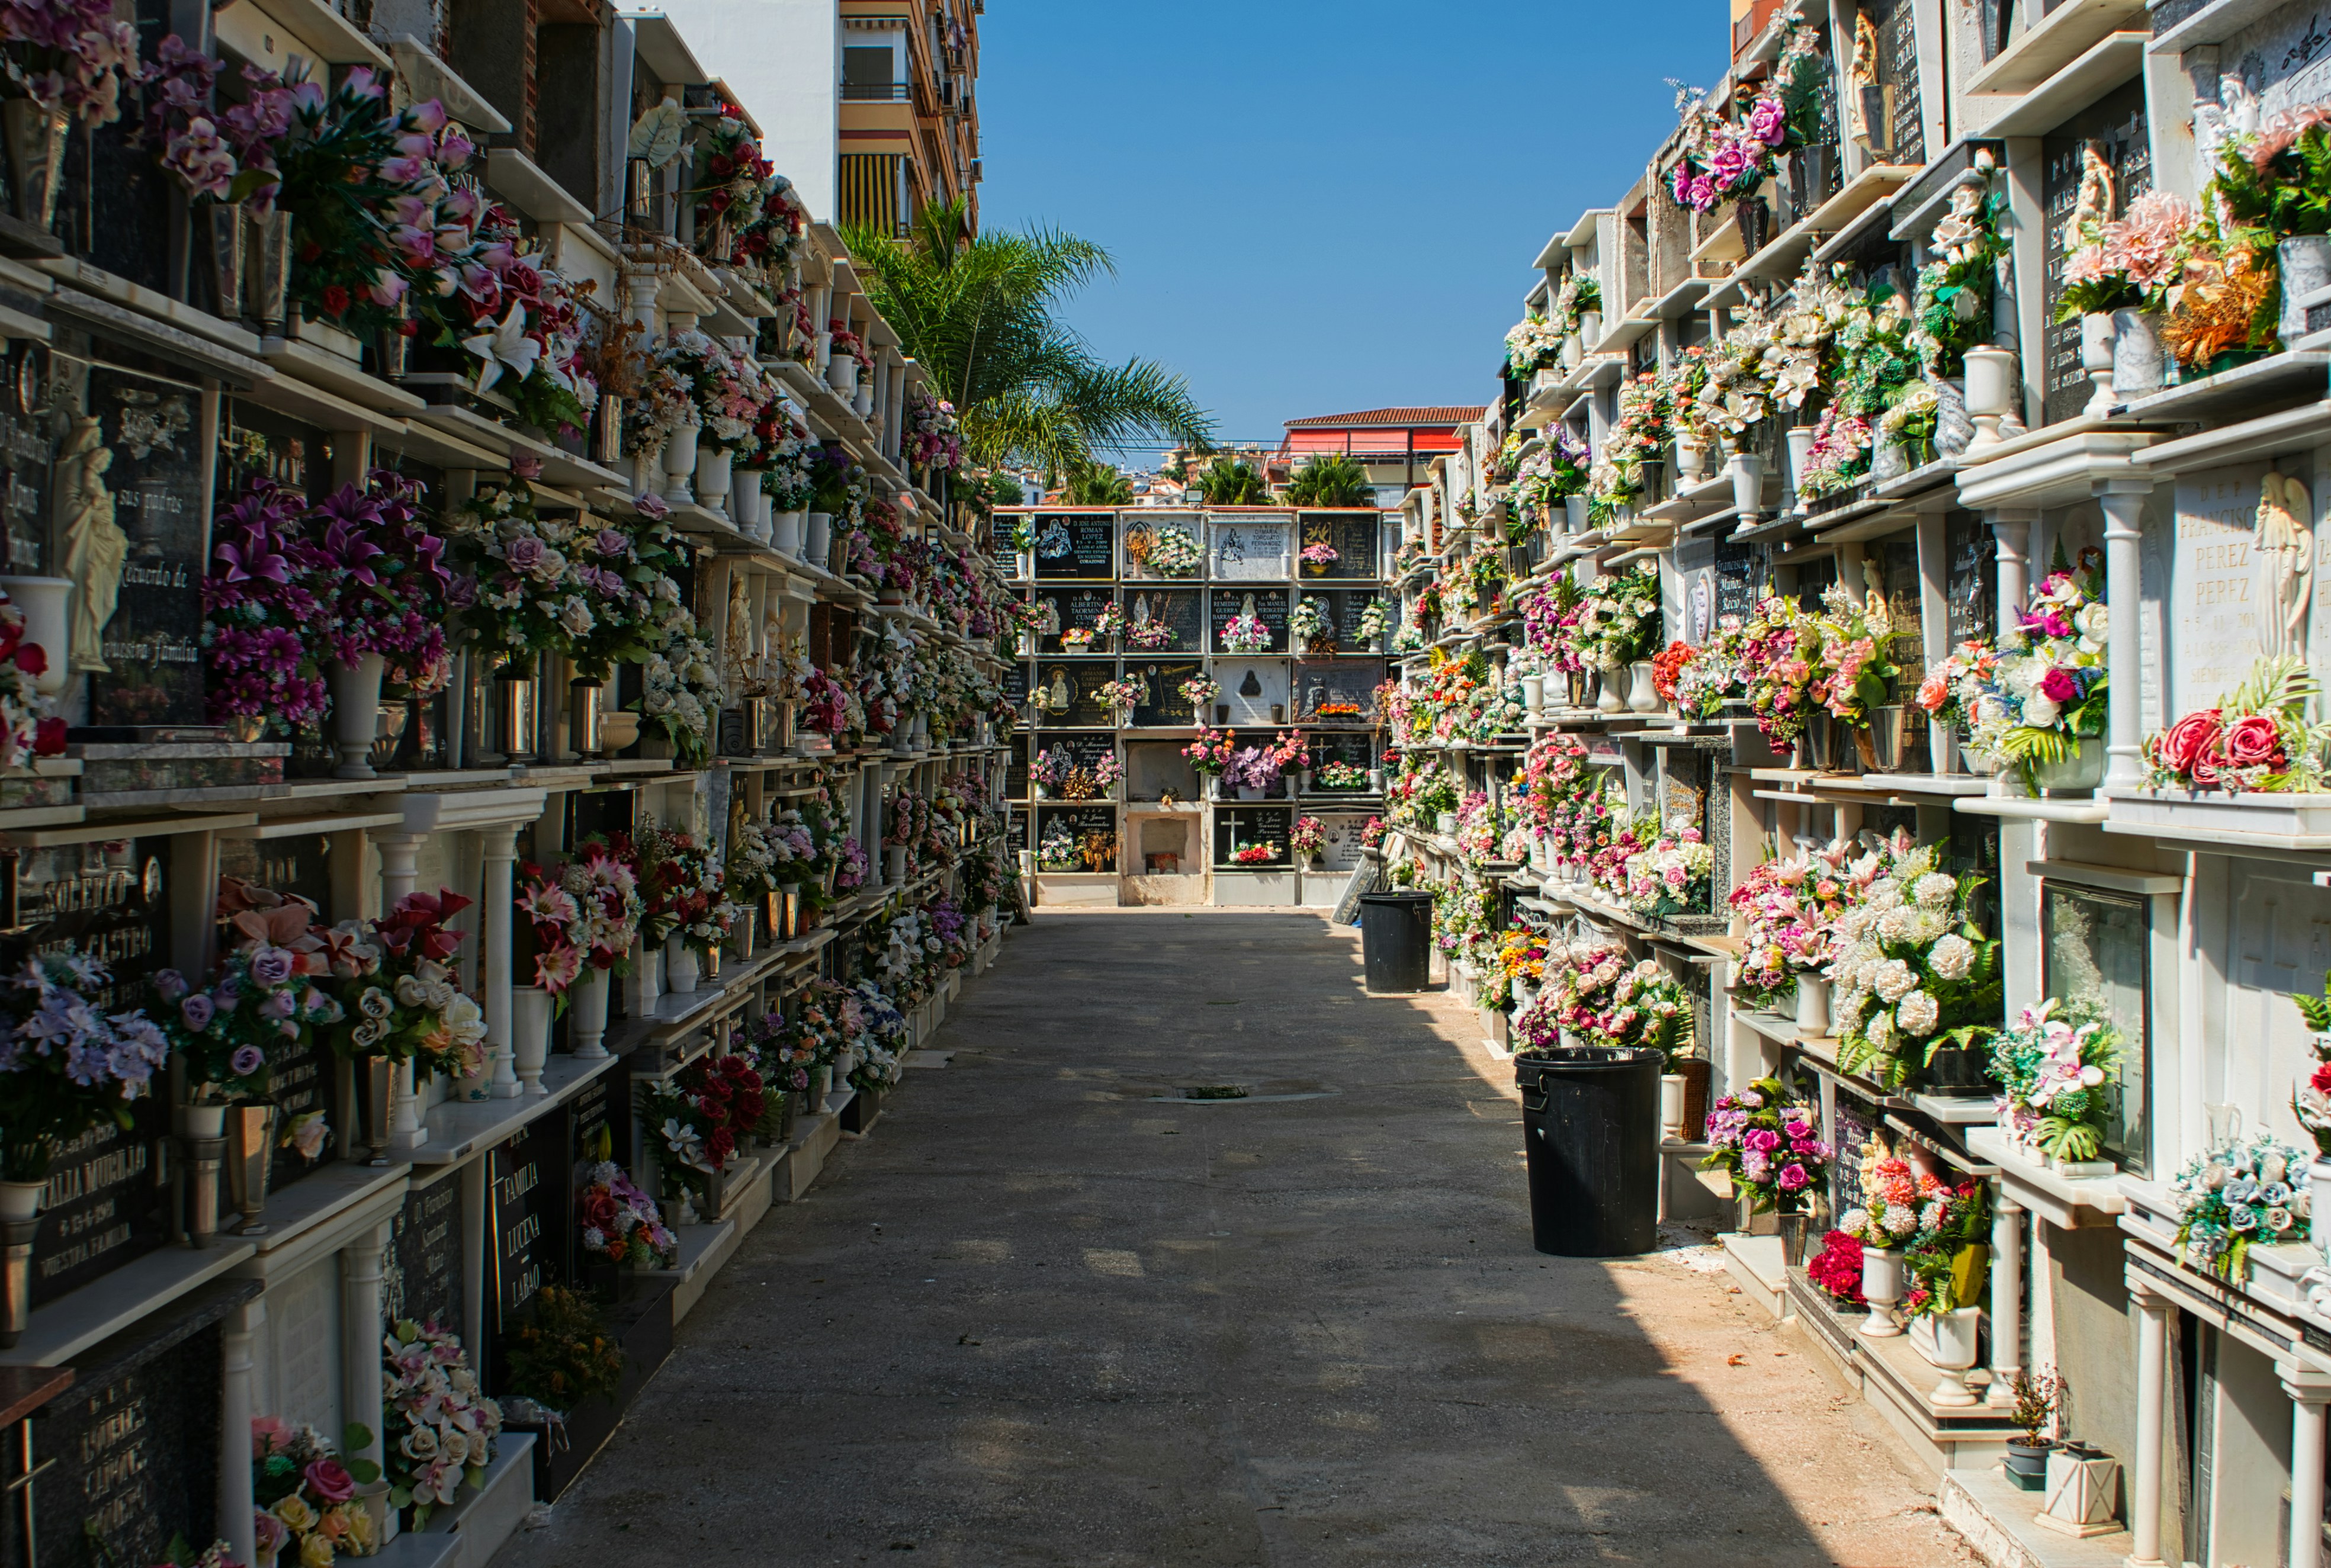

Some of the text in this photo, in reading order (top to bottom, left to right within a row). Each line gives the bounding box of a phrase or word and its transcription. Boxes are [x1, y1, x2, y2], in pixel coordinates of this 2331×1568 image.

[145, 487, 183, 518] padres
[2179, 506, 2257, 539] FRANCISC
[2194, 541, 2250, 571] PEREZ
[172, 562, 188, 588] de
[1719, 577, 1742, 592] Muñoz
[1722, 596, 1740, 611] Recio
[2195, 577, 2250, 606] PEREZ
[151, 635, 198, 670] familia
[1090, 814, 1106, 822] Juan
[505, 1161, 538, 1206] FAMILIA
[508, 1212, 540, 1258] LUCENA
